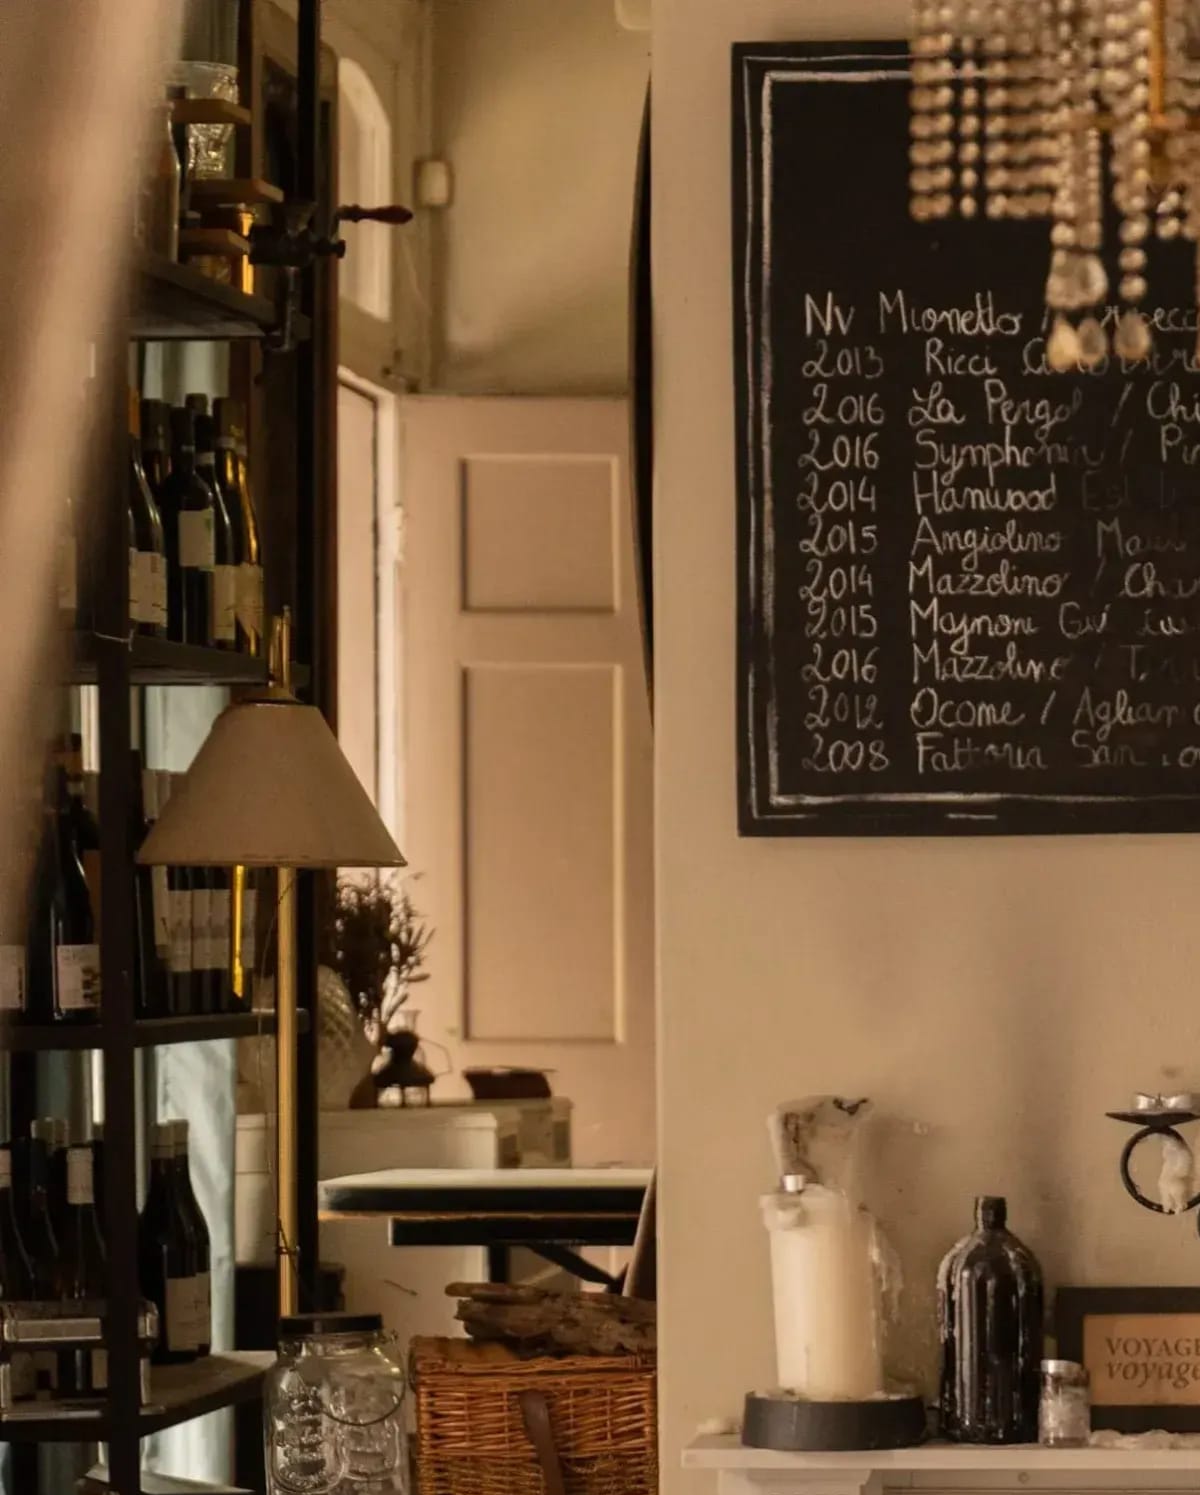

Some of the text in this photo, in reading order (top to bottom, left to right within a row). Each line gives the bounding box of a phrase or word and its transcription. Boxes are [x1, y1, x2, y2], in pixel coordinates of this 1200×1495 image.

[801, 338, 885, 380] 2013
[925, 336, 999, 378] Ricci
[802, 383, 886, 425] 2016
[798, 429, 881, 471] 2016
[797, 472, 878, 514] 2014
[910, 468, 1058, 516] Hanwood
[799, 513, 878, 558] 2015
[799, 557, 875, 600] 2014
[908, 553, 1072, 598] Mazzolino
[804, 596, 880, 640] 2015
[801, 641, 882, 684] 2016
[801, 732, 892, 774] 2008
